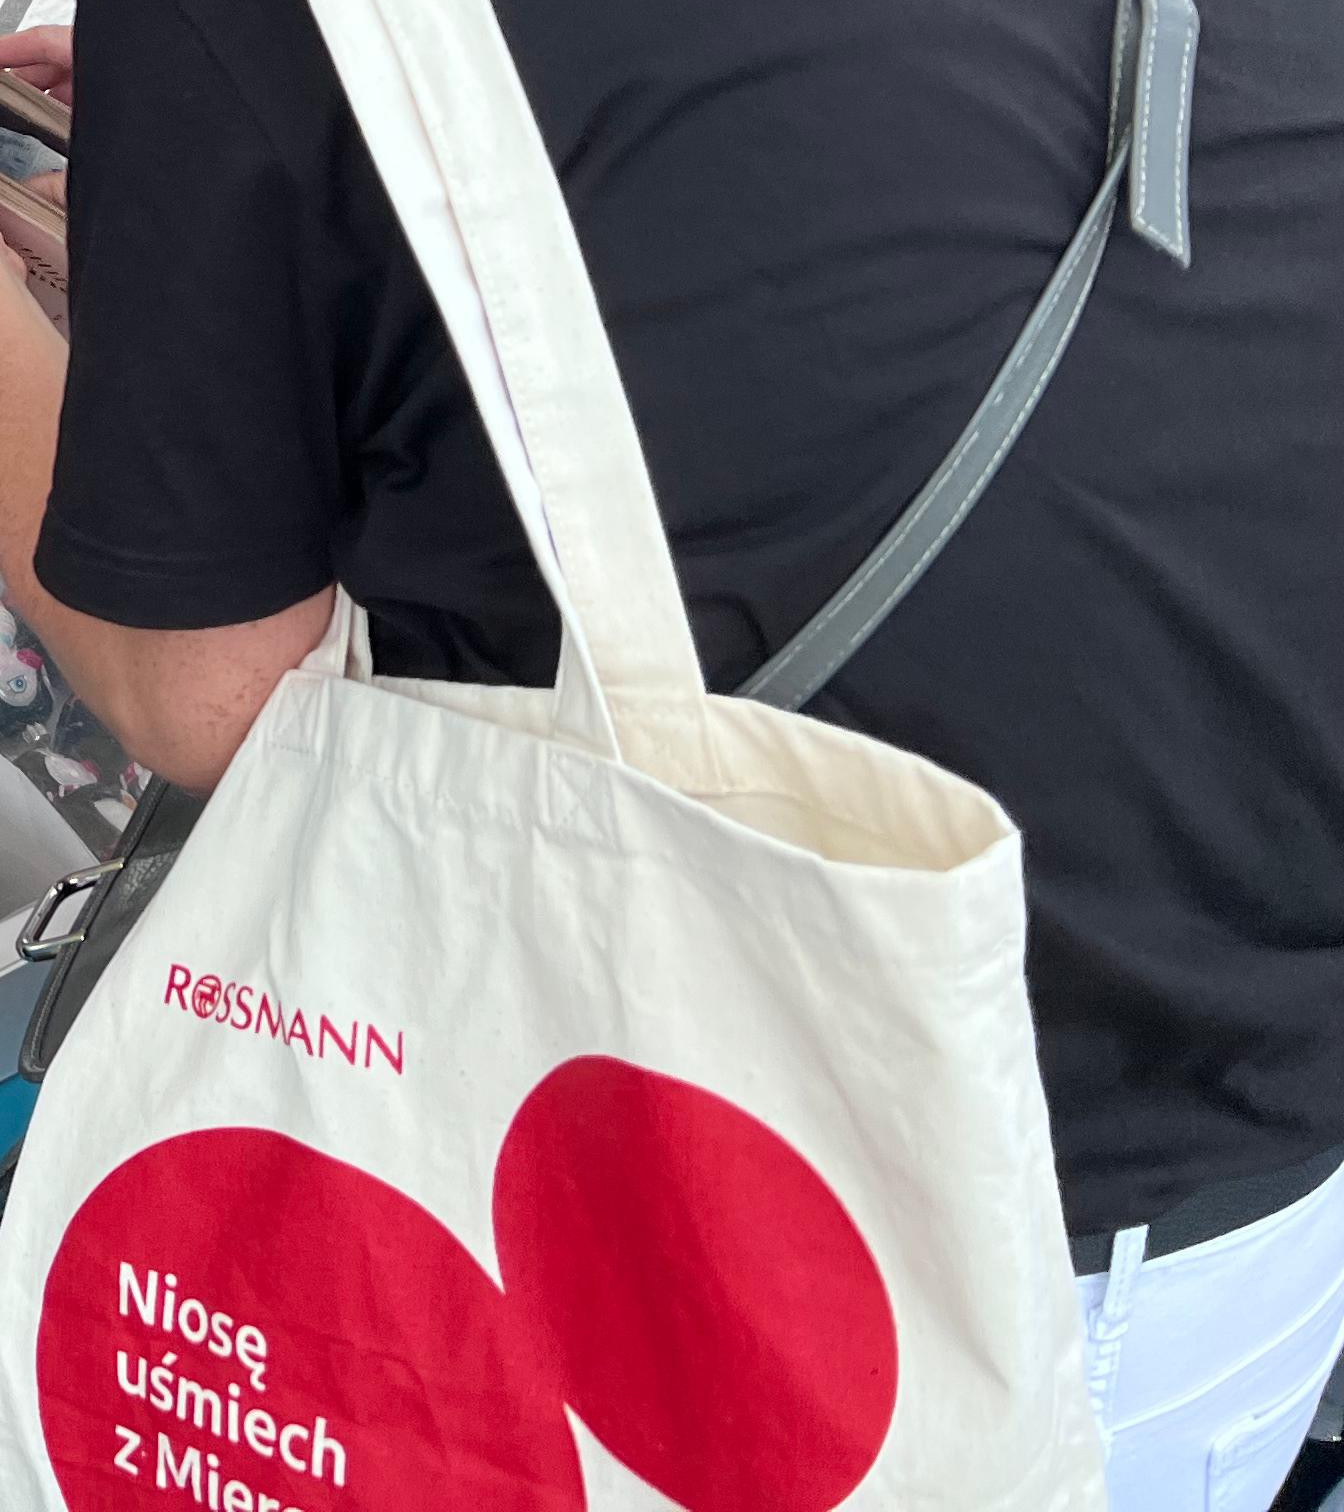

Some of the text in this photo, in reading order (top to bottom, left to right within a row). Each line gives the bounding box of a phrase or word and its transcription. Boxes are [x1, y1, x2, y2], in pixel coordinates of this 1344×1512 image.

[163, 963, 404, 1076] ROSSMANN
[118, 1261, 269, 1393] Niosę
[113, 1423, 306, 1512] z Mier
[115, 1349, 348, 1488] uśmiech
